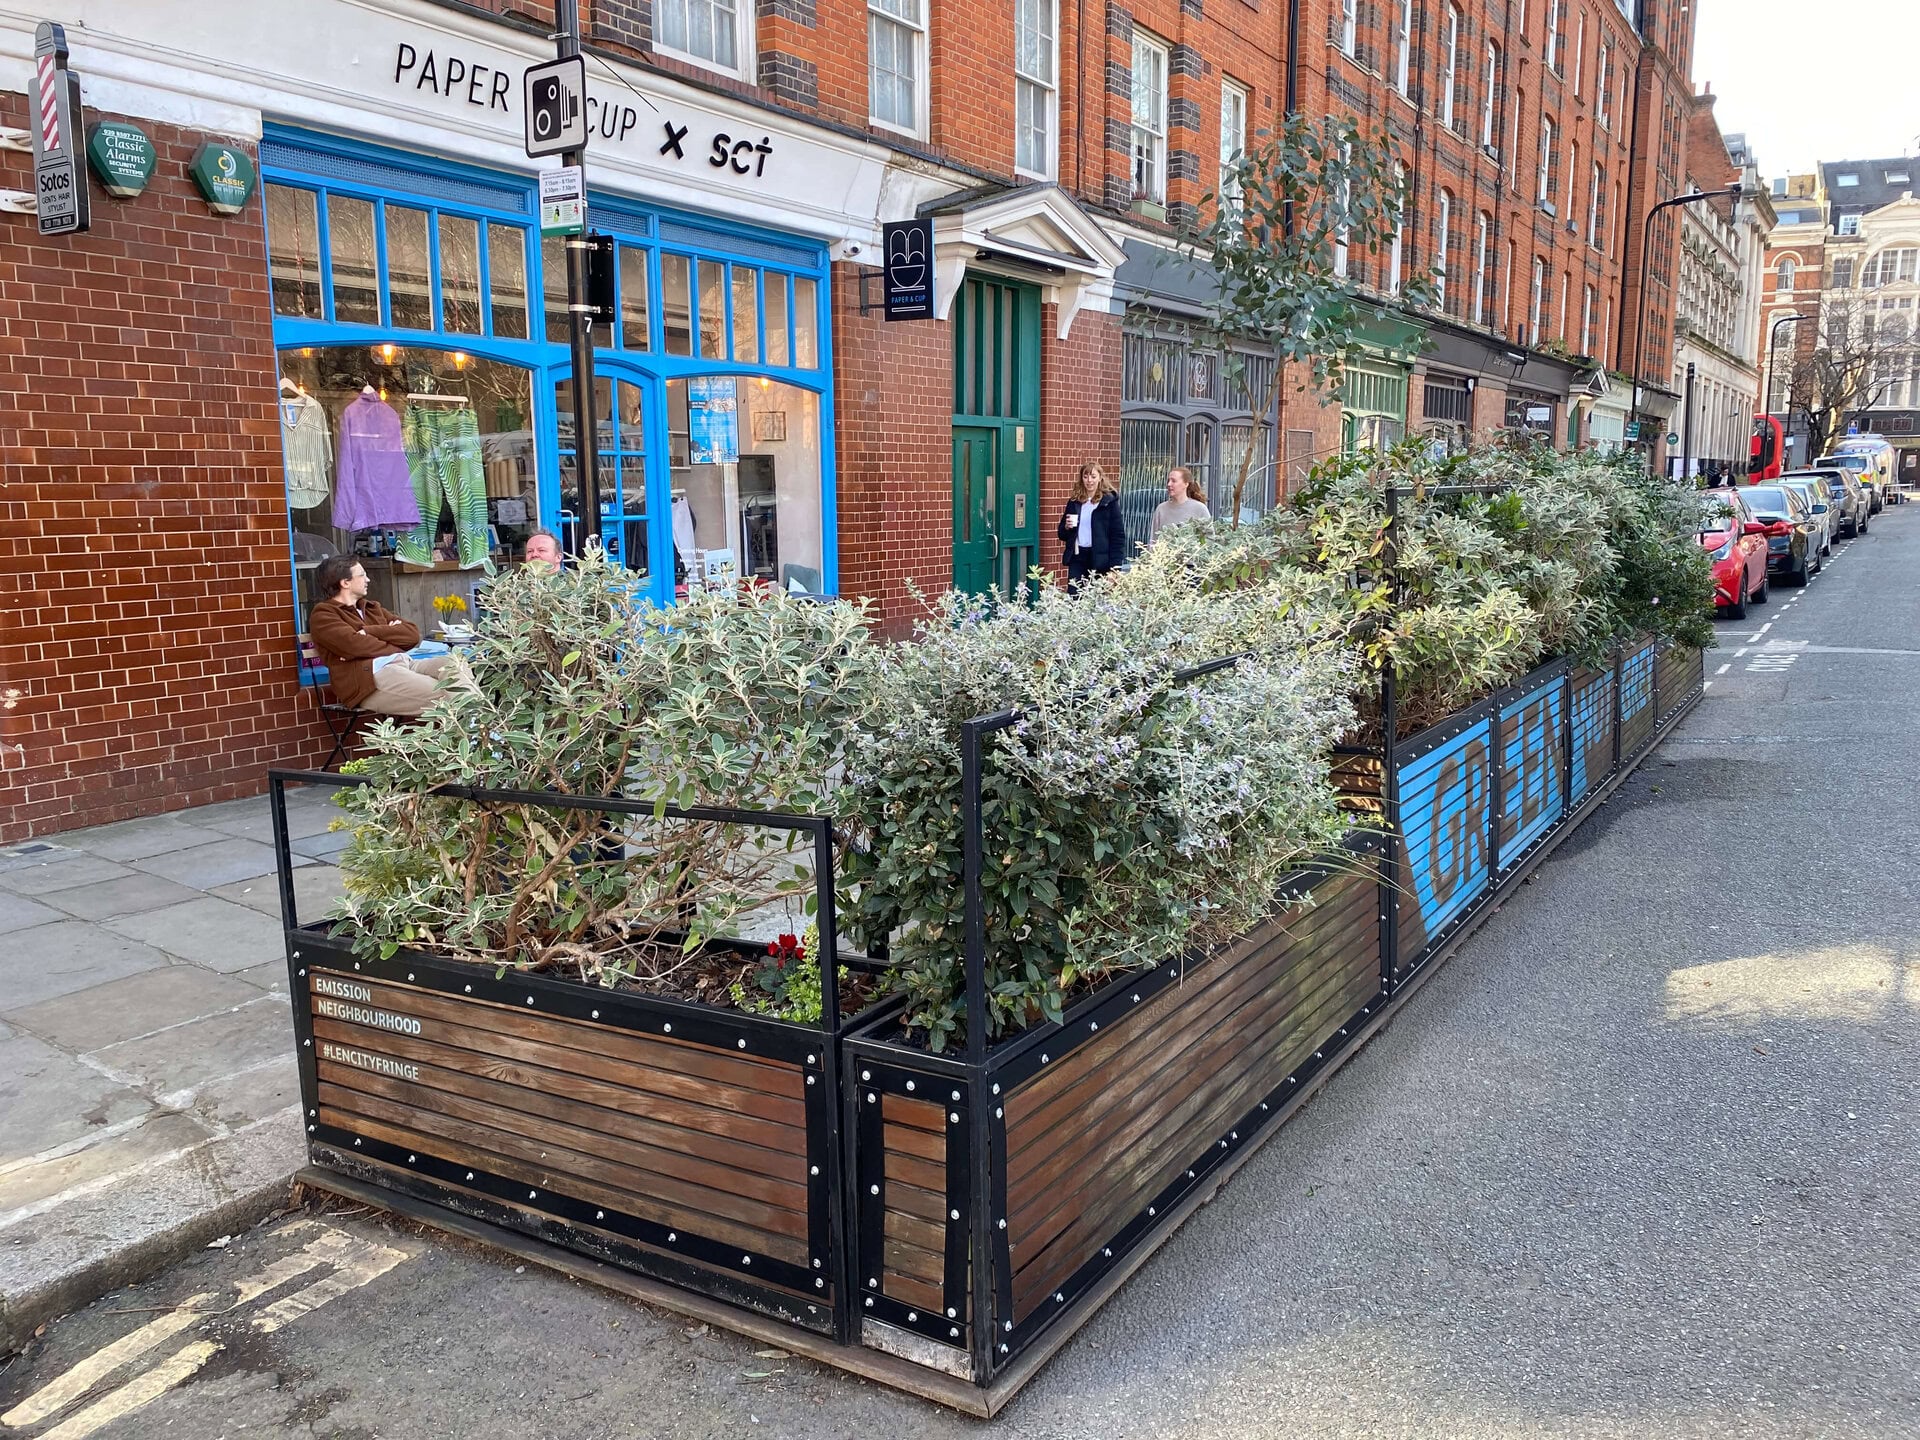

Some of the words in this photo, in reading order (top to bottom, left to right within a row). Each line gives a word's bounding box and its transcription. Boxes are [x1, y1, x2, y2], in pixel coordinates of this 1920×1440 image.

[395, 42, 510, 112] PAPER
[660, 121, 688, 160] X
[106, 136, 144, 152] Classic
[106, 148, 146, 164] Alarms
[109, 160, 136, 168] SECURITY
[40, 173, 69, 192] Sotos
[212, 176, 244, 187] CLASSIC
[58, 192, 70, 200] HAIR
[584, 316, 592, 333] 7
[1430, 689, 1564, 905] GREEN
[316, 978, 371, 1002] EMISSION
[318, 1000, 421, 1034] NEIGHBOURHOOD
[323, 1044, 419, 1080] #LENCITYFRINGE
